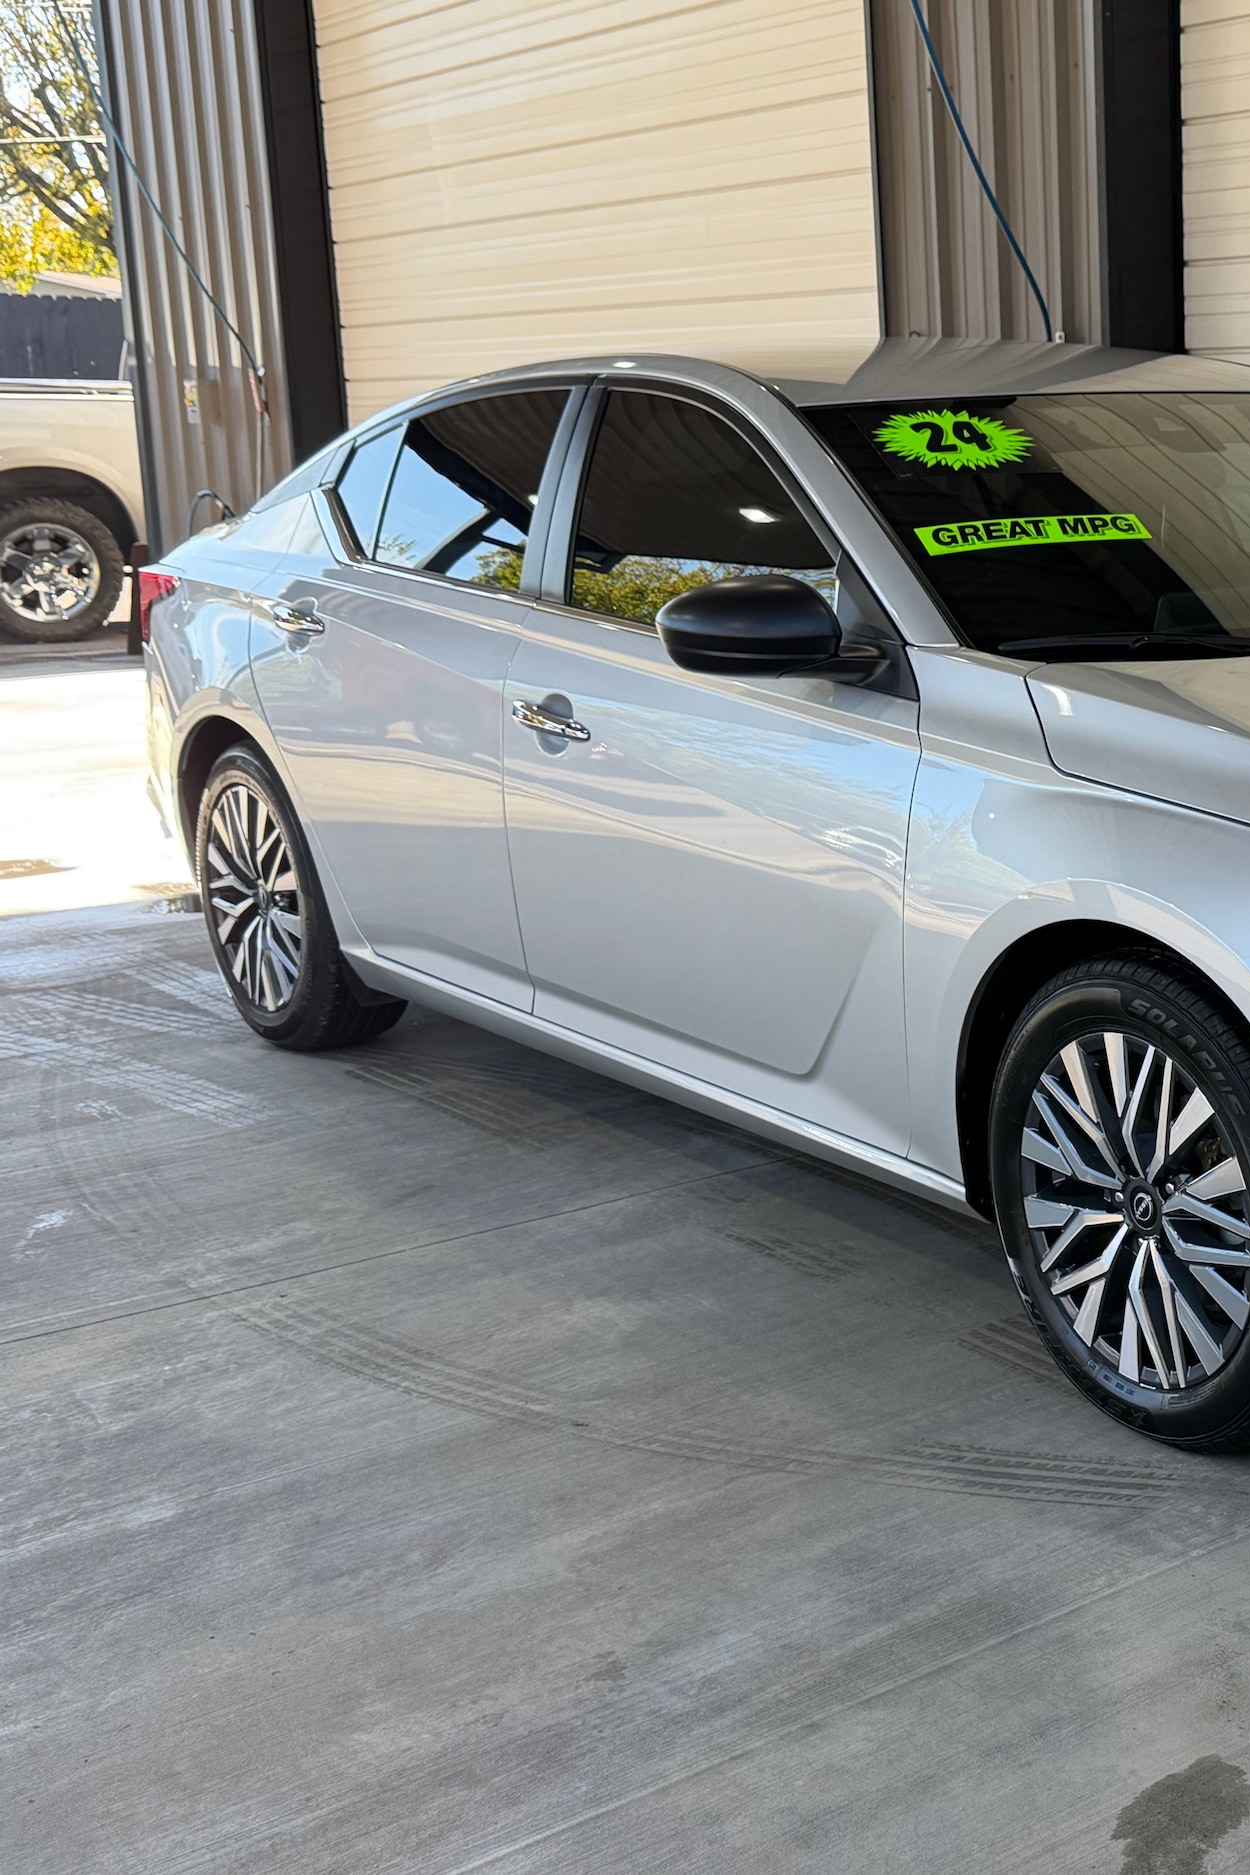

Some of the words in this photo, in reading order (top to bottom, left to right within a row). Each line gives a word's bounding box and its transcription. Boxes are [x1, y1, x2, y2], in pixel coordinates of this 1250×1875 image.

[910, 420, 994, 454] 24
[931, 518, 1049, 547] GREAT
[1057, 515, 1137, 538] MPG
